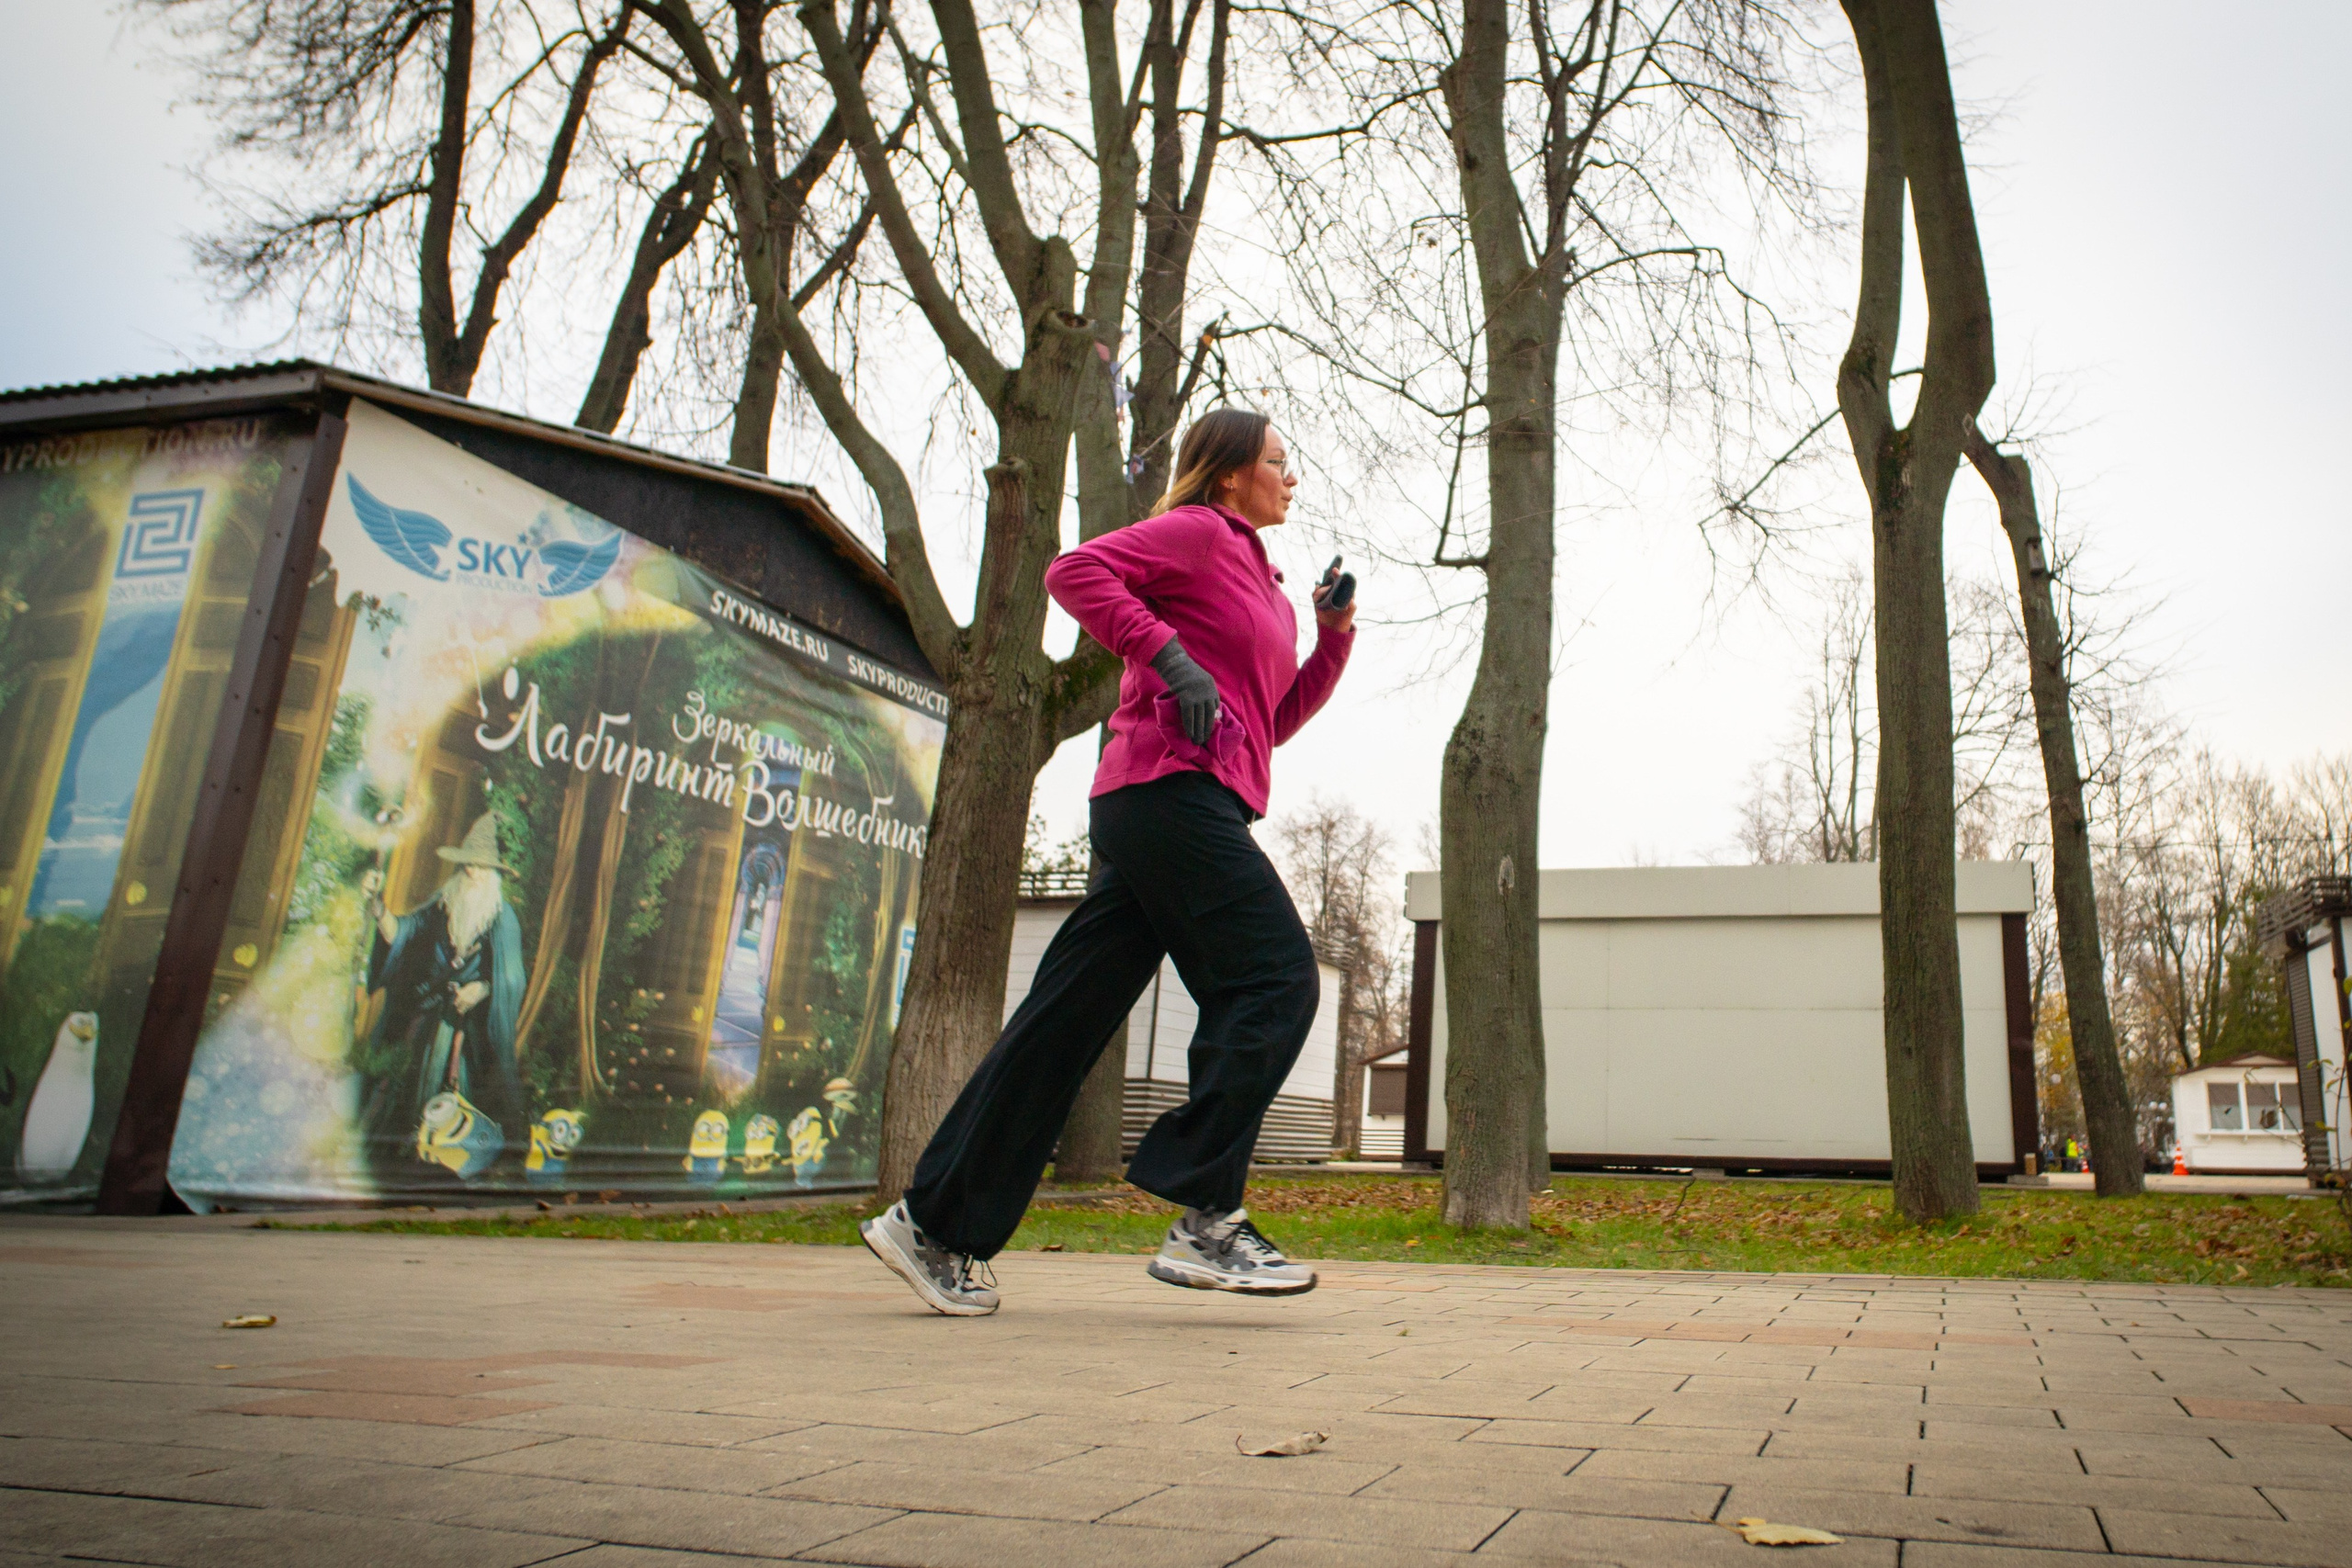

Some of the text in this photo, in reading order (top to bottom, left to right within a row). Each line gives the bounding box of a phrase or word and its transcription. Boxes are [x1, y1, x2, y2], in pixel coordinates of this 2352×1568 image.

[457, 537, 533, 579] SKY
[709, 590, 949, 716] SKYMAZE.RU SKYPRODUCTI
[474, 682, 927, 859] Лабиринт Волшебник
[673, 690, 836, 776] Зеркальный
